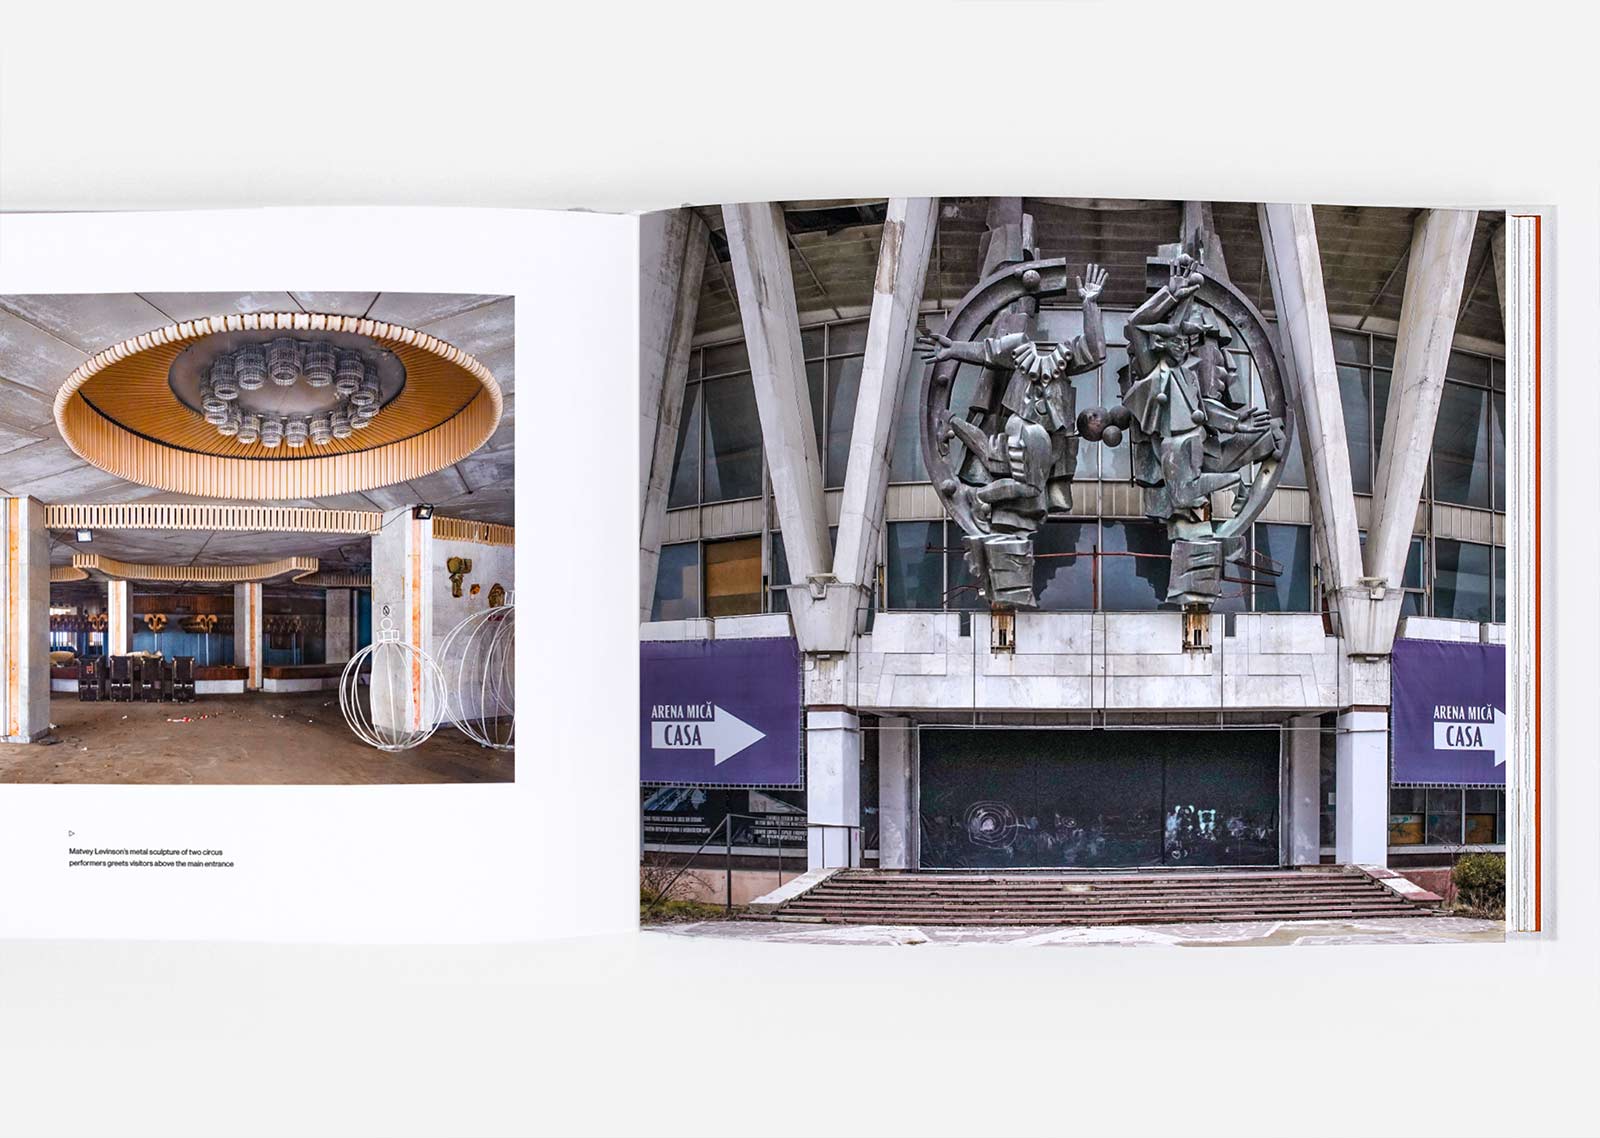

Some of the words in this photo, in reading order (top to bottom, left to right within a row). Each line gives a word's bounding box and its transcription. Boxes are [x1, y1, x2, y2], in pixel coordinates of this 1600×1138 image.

[651, 704, 684, 719] ARENA
[686, 701, 712, 719] MICĂ
[1434, 705, 1466, 720] ARENA
[1468, 704, 1492, 720] MICĂ
[664, 724, 702, 746] CASA
[1446, 725, 1483, 747] CASA
